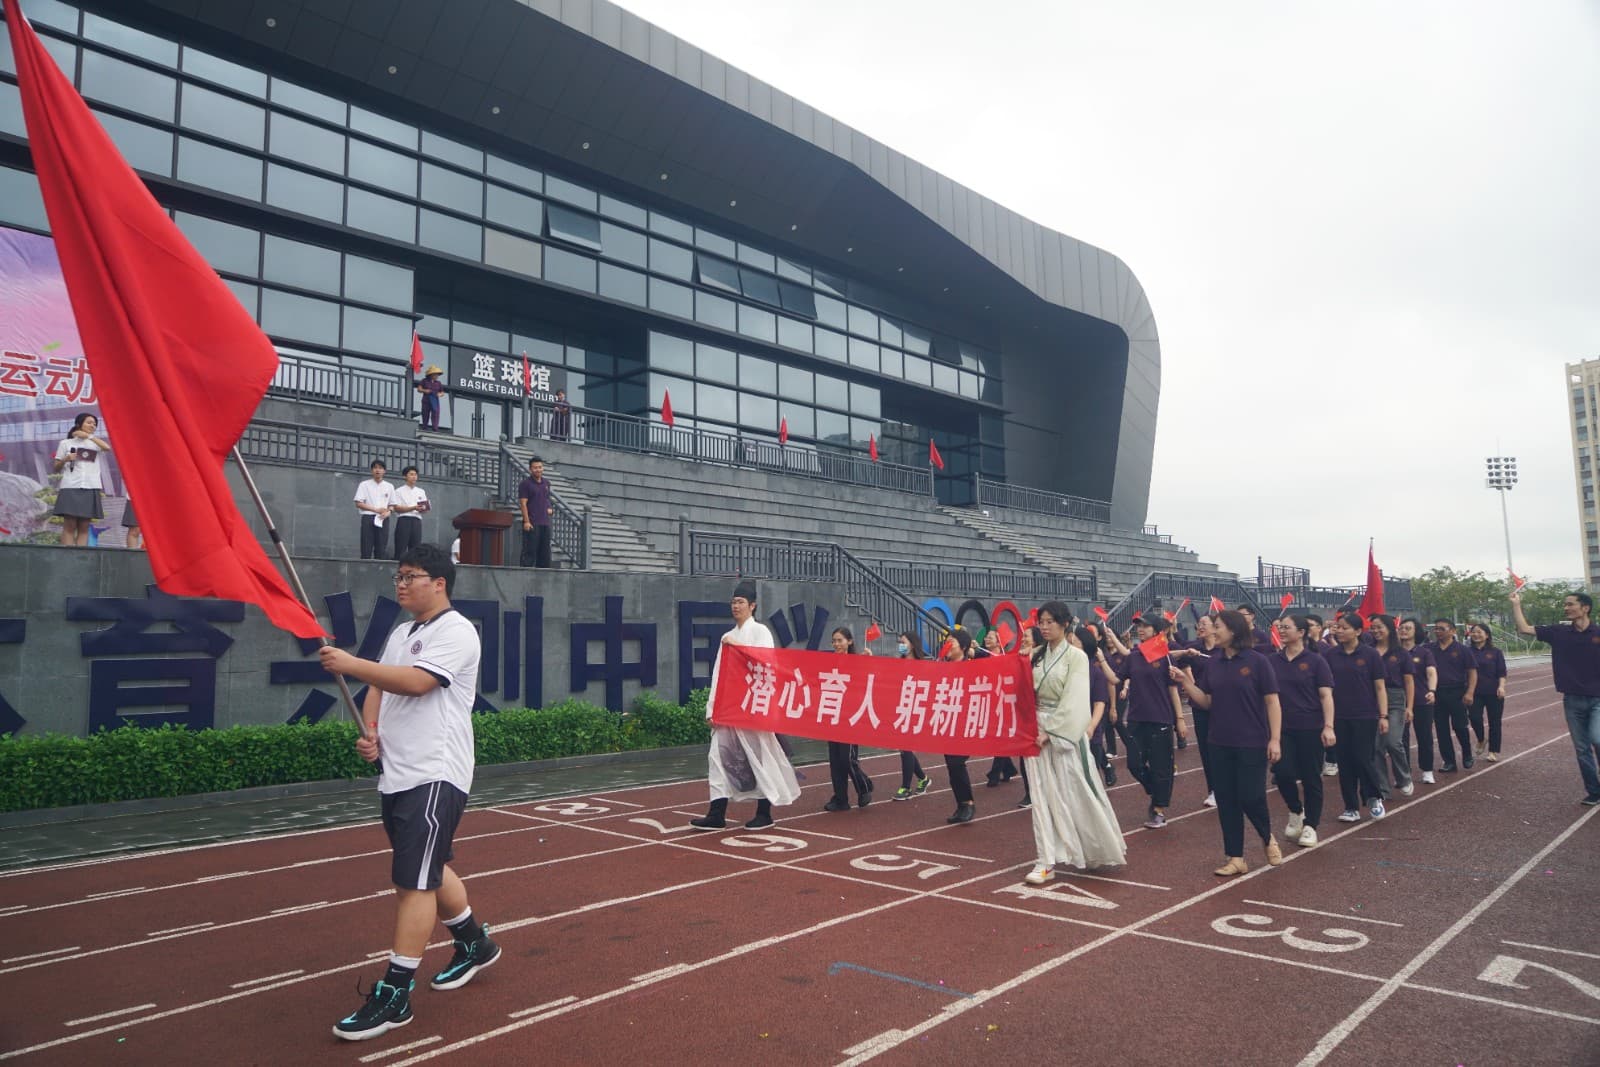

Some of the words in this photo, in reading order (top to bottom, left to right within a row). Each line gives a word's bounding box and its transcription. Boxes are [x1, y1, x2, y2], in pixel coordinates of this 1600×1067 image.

[472, 352, 551, 392] 篮球馆
[741, 661, 880, 729] 潜心育人
[894, 674, 1017, 739] 躬耕前行
[720, 834, 809, 852] 6
[849, 854, 961, 880] 5
[992, 882, 1120, 910] 4
[1210, 914, 1370, 953] 3
